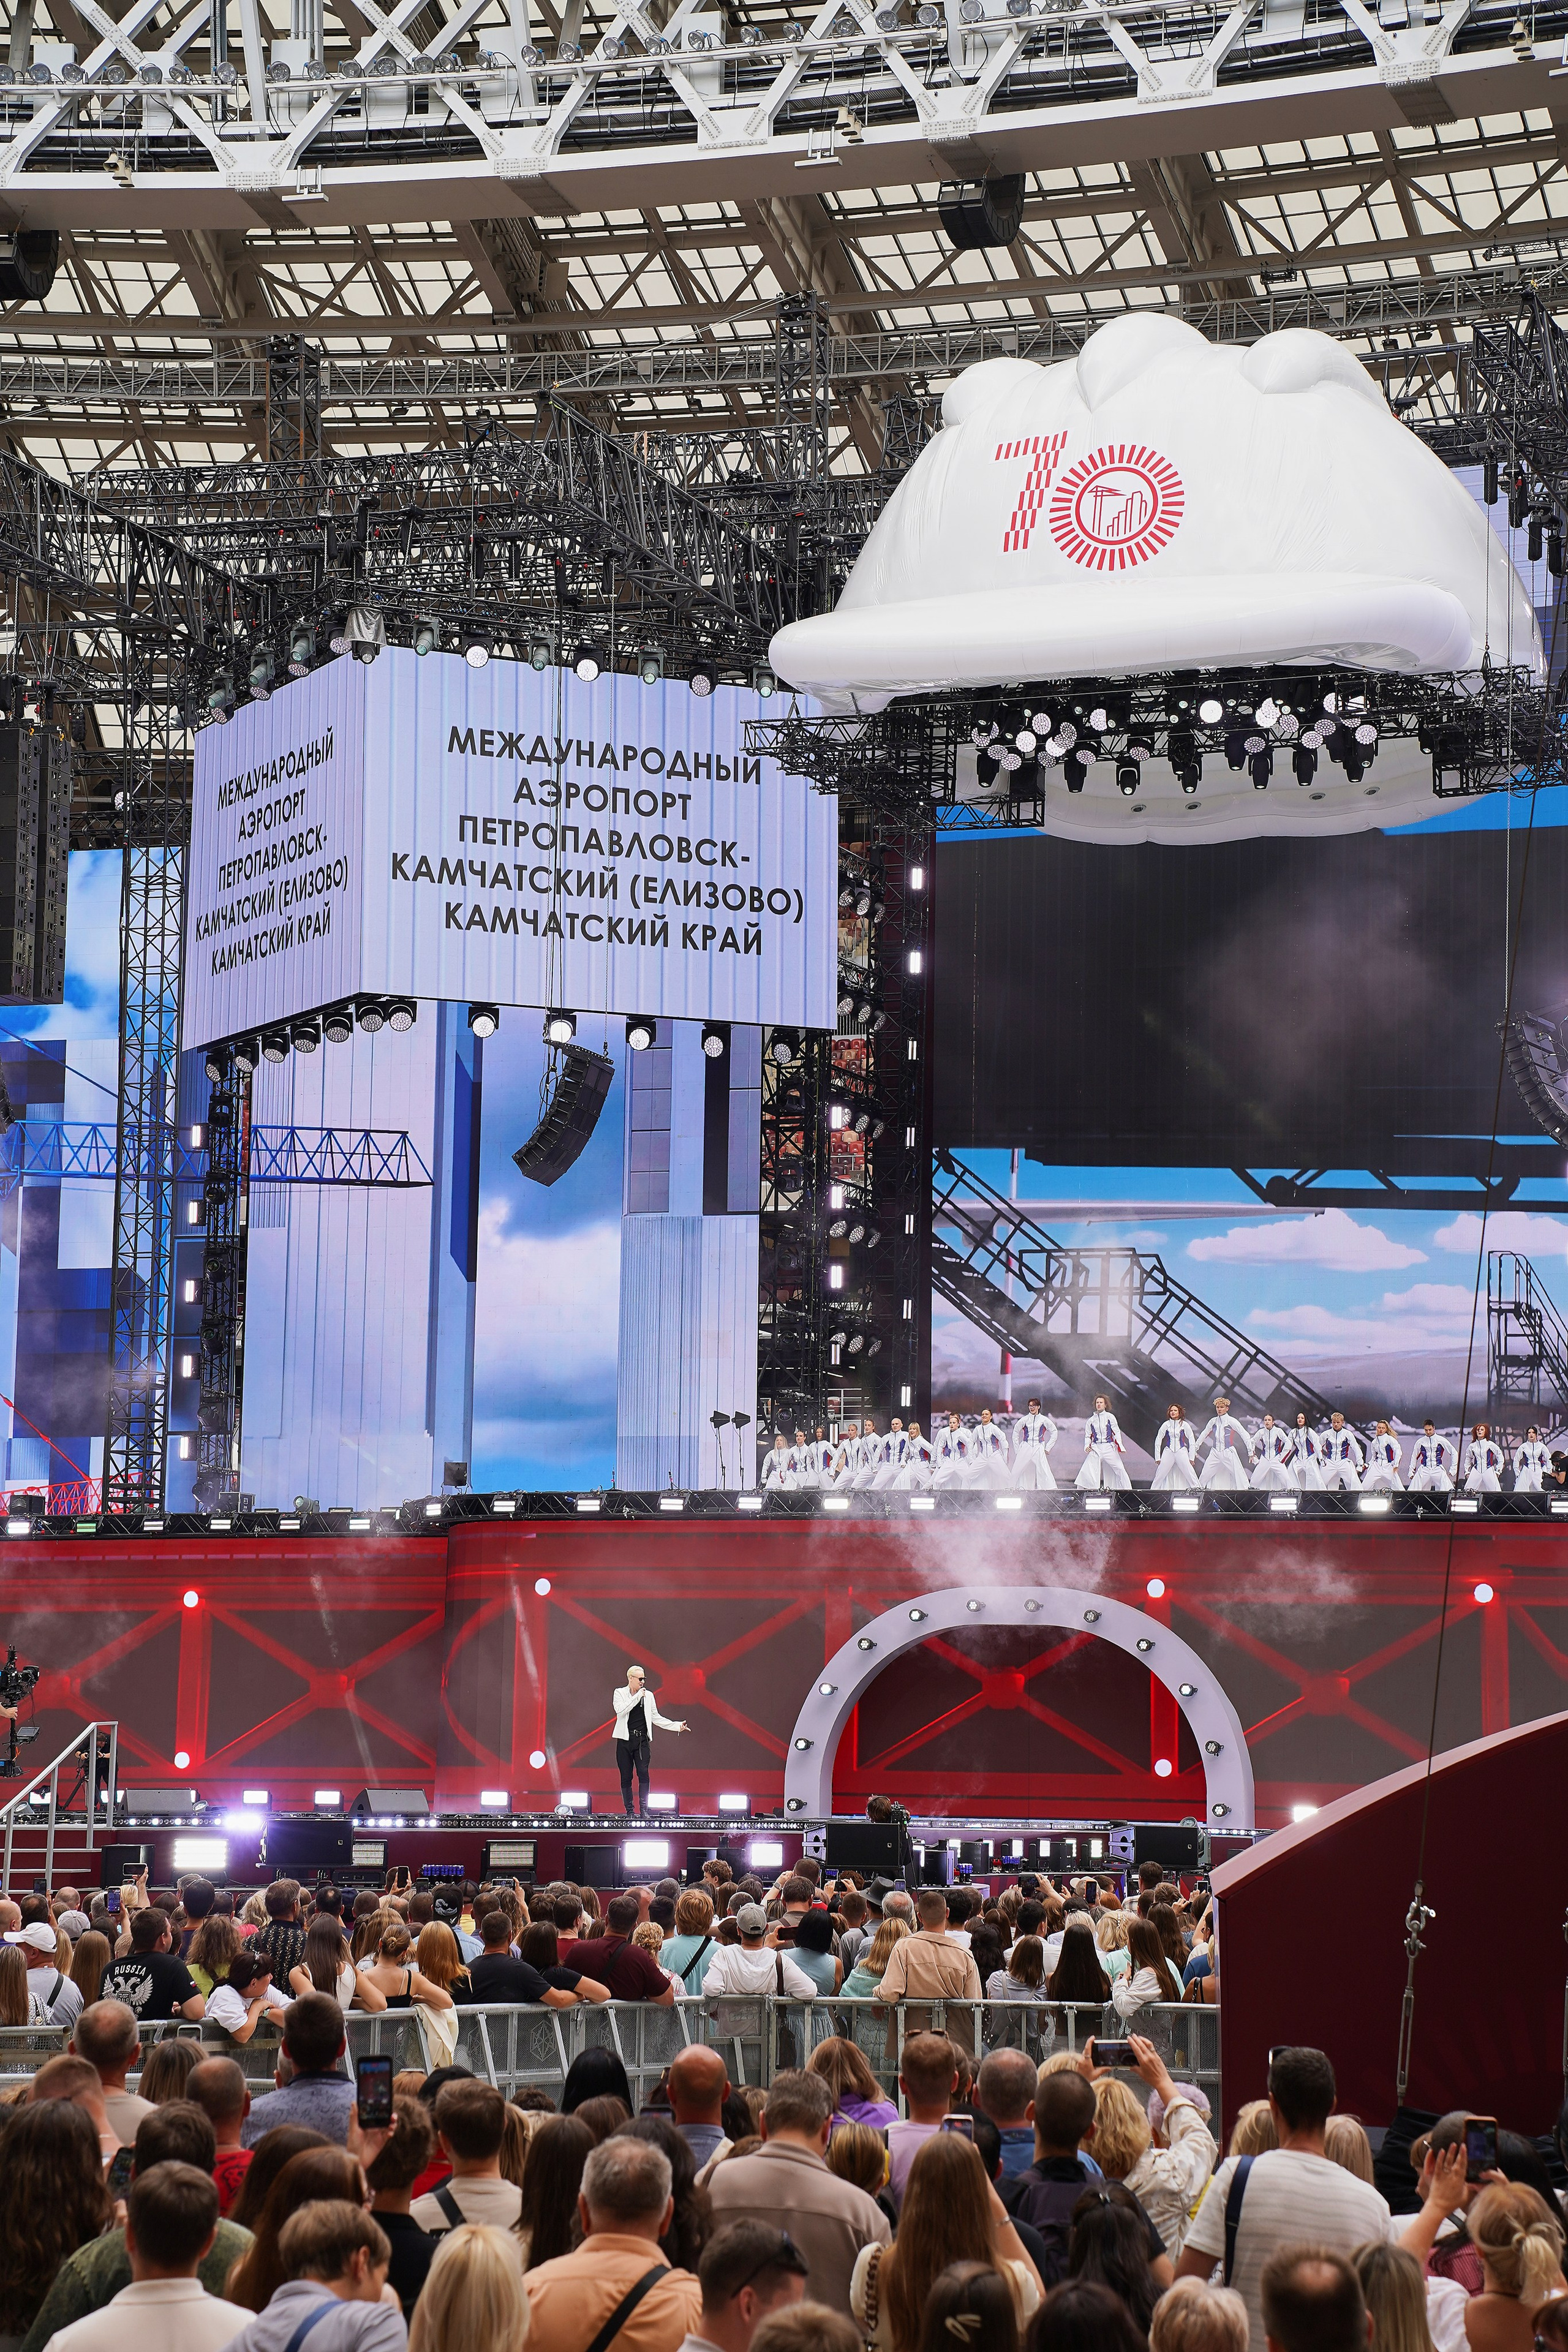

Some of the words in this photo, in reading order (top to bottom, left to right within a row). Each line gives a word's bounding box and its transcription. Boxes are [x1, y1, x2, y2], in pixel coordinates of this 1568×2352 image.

[217, 725, 333, 811] МЕЖДУНАРОДНЫЙ
[448, 725, 761, 785] МЕЖДУНАРОДНЫЙ
[238, 788, 306, 842] АЭРОПОРТ
[513, 777, 692, 821] АЭРОПОРТ
[219, 823, 327, 892] ПЕТРОПАВЛОВСК-
[459, 815, 749, 869] ПЕТРОПАВЛОВСК-
[196, 879, 275, 943] КАМЧАТСКИЙ
[277, 855, 348, 917] (ЕЛИЗОВО)
[393, 852, 618, 900] КАМЧАТСКИЙ
[630, 874, 804, 923] (ЕЛИЗОВО)
[211, 914, 293, 977] КАМЧАТСКИЙ
[298, 900, 331, 945] КРАЙ
[446, 902, 669, 948] КАМЧАТСКИЙ
[682, 921, 762, 956] КРАЙ
[115, 1964, 146, 1977] RUSSIA
